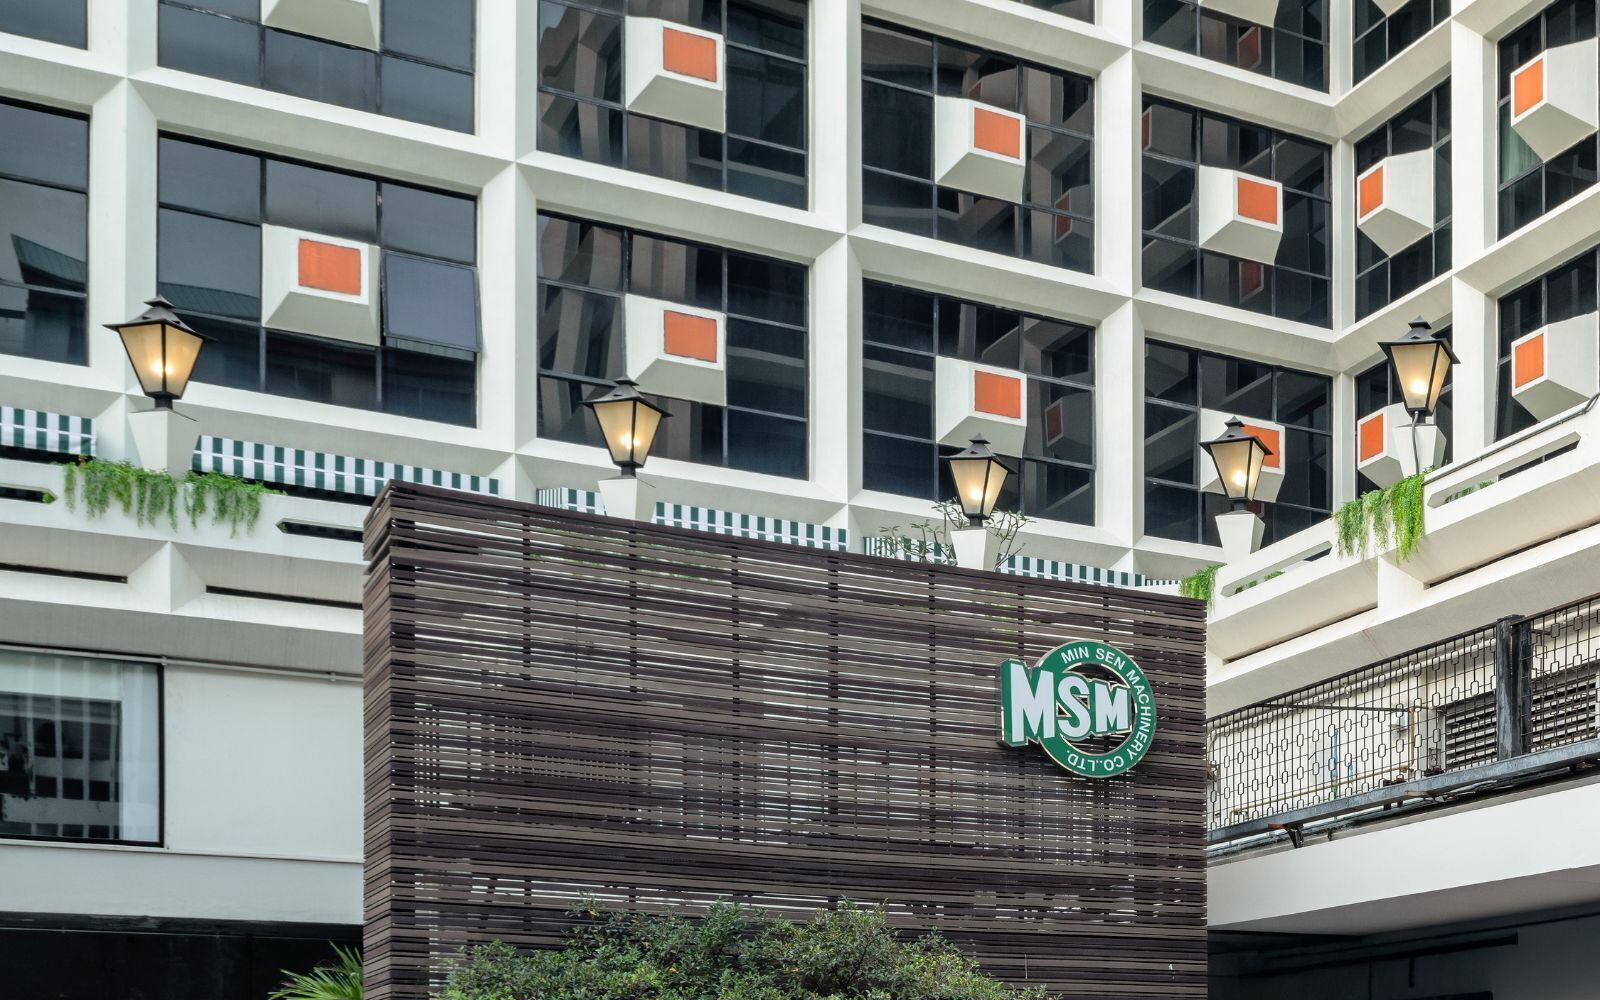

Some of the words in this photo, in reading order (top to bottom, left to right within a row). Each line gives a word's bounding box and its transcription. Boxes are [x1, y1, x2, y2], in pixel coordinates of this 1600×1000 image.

[1010, 662, 1130, 744] MSM
[1060, 646, 1090, 664] MIN
[1095, 648, 1126, 671] SEN
[1126, 669, 1152, 760] MACHINERY
